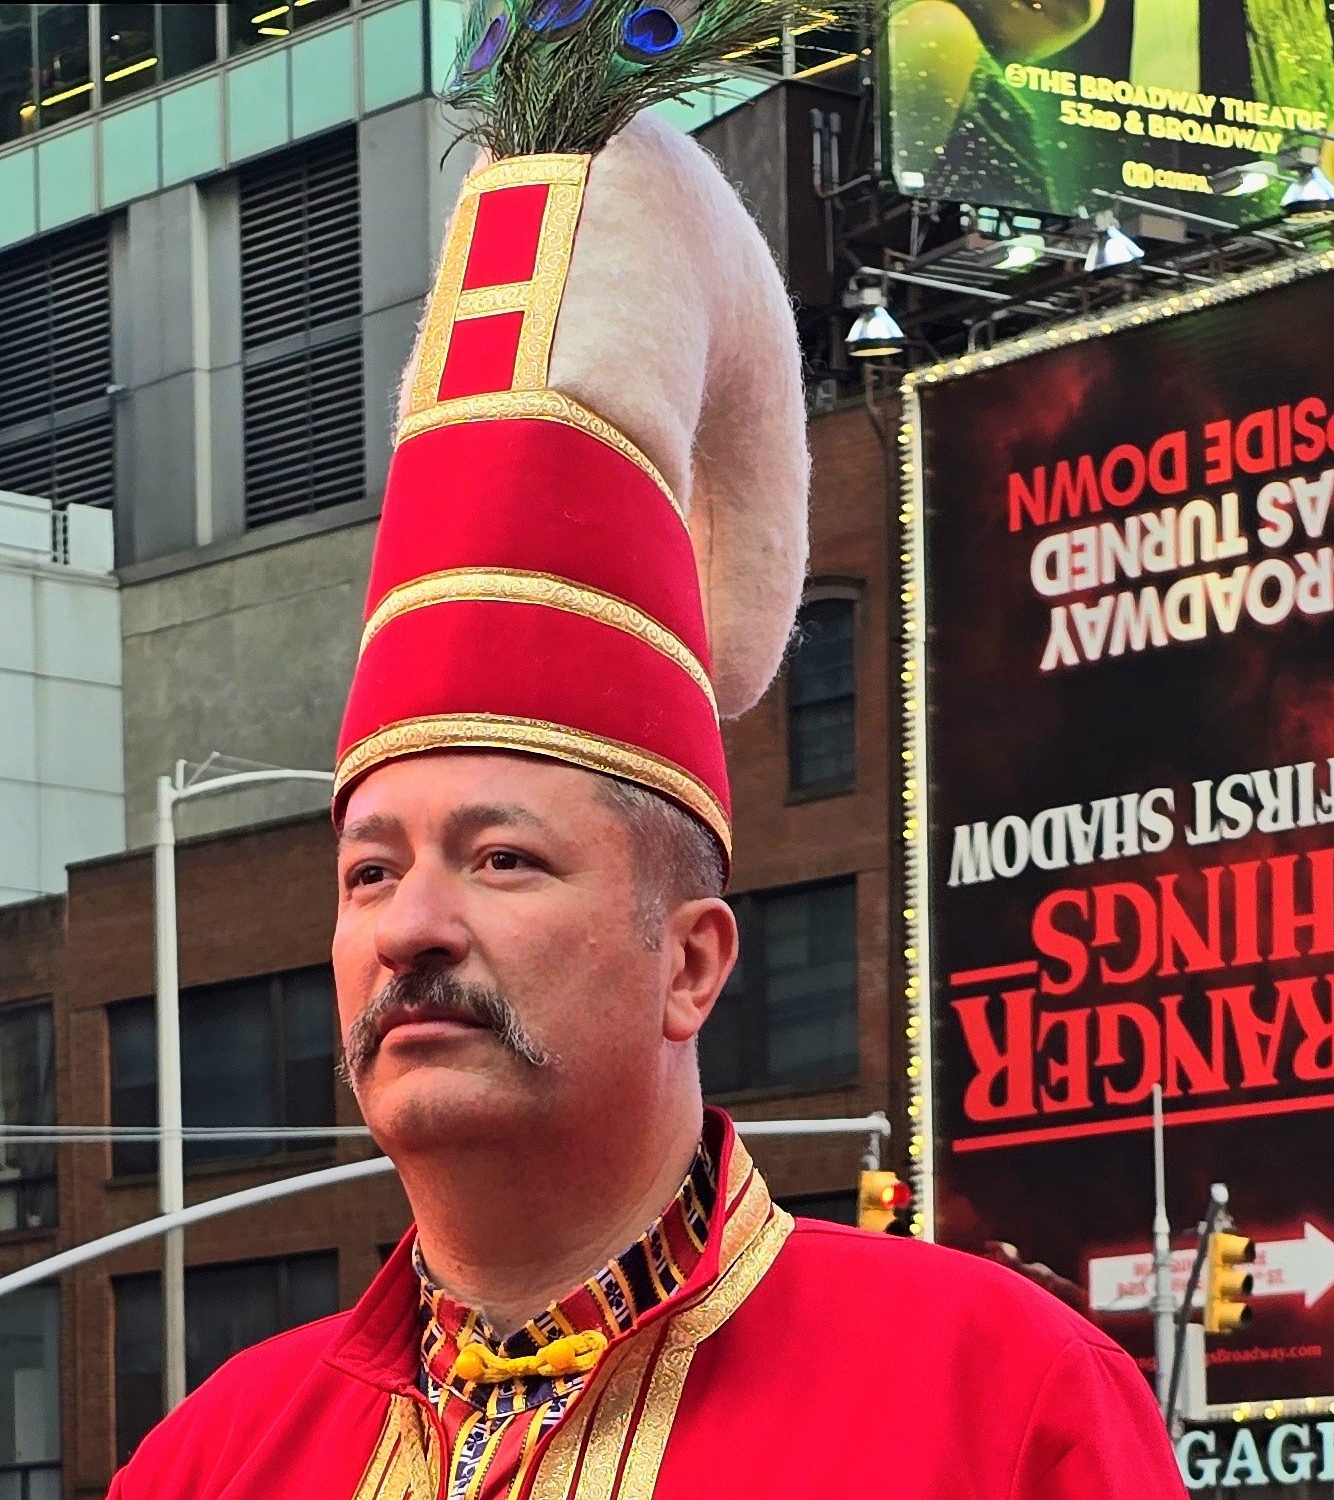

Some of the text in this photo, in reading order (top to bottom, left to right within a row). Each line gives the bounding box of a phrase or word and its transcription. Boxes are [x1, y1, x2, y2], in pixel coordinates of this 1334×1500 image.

[1080, 74, 1217, 117] BROADWAY
[1220, 97, 1328, 130] THEATRE
[1124, 110, 1145, 136] &
[1148, 114, 1284, 154] BROADWAY
[1008, 430, 1188, 532] DOWN
[1029, 491, 1248, 599] TURNED
[947, 788, 1174, 887] SHADOW
